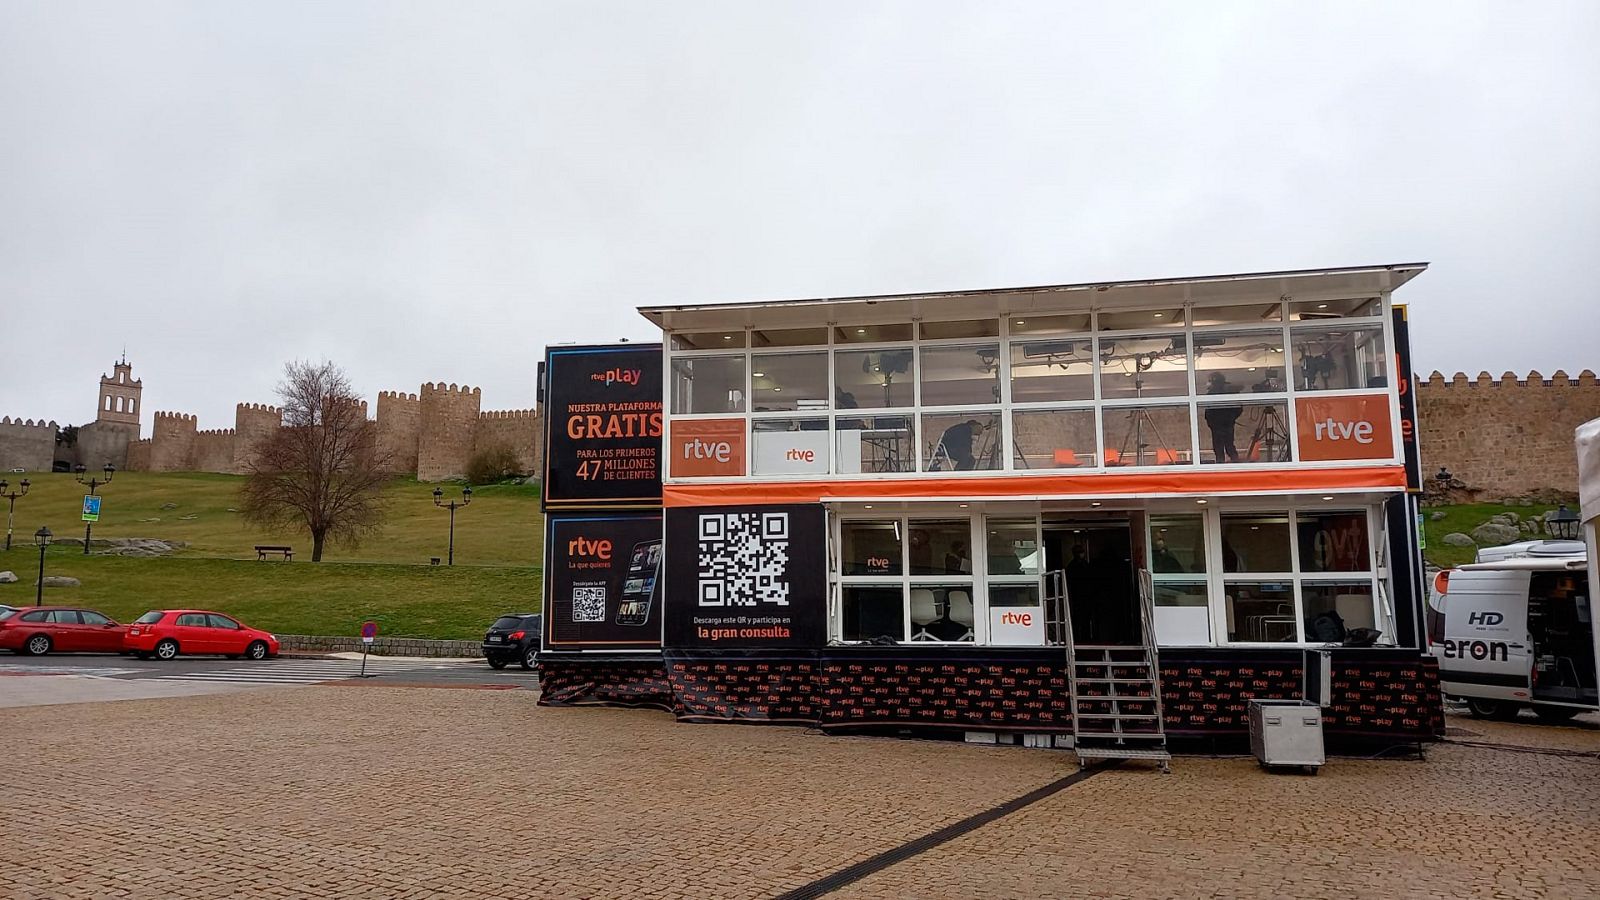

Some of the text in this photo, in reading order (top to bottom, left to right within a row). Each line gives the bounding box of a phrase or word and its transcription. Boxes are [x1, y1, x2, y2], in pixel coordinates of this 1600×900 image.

[606, 368, 641, 386] play
[568, 402, 662, 412] NUESTRA PLATAFORMA
[568, 412, 662, 439] GRATIS
[1315, 418, 1374, 444] rtve
[577, 448, 656, 458] PARA LOS PRIMEROS
[684, 438, 731, 462] rtve
[786, 448, 814, 462] rtve
[576, 459, 656, 480] 47 MILLONES
[604, 470, 656, 480] DE CLIENTES
[568, 537, 612, 560] rtve
[868, 556, 889, 568] rtve
[694, 616, 721, 624] Descarga
[1002, 612, 1031, 626] rtve
[1469, 612, 1504, 625] HD
[698, 626, 790, 640] la gran consulta
